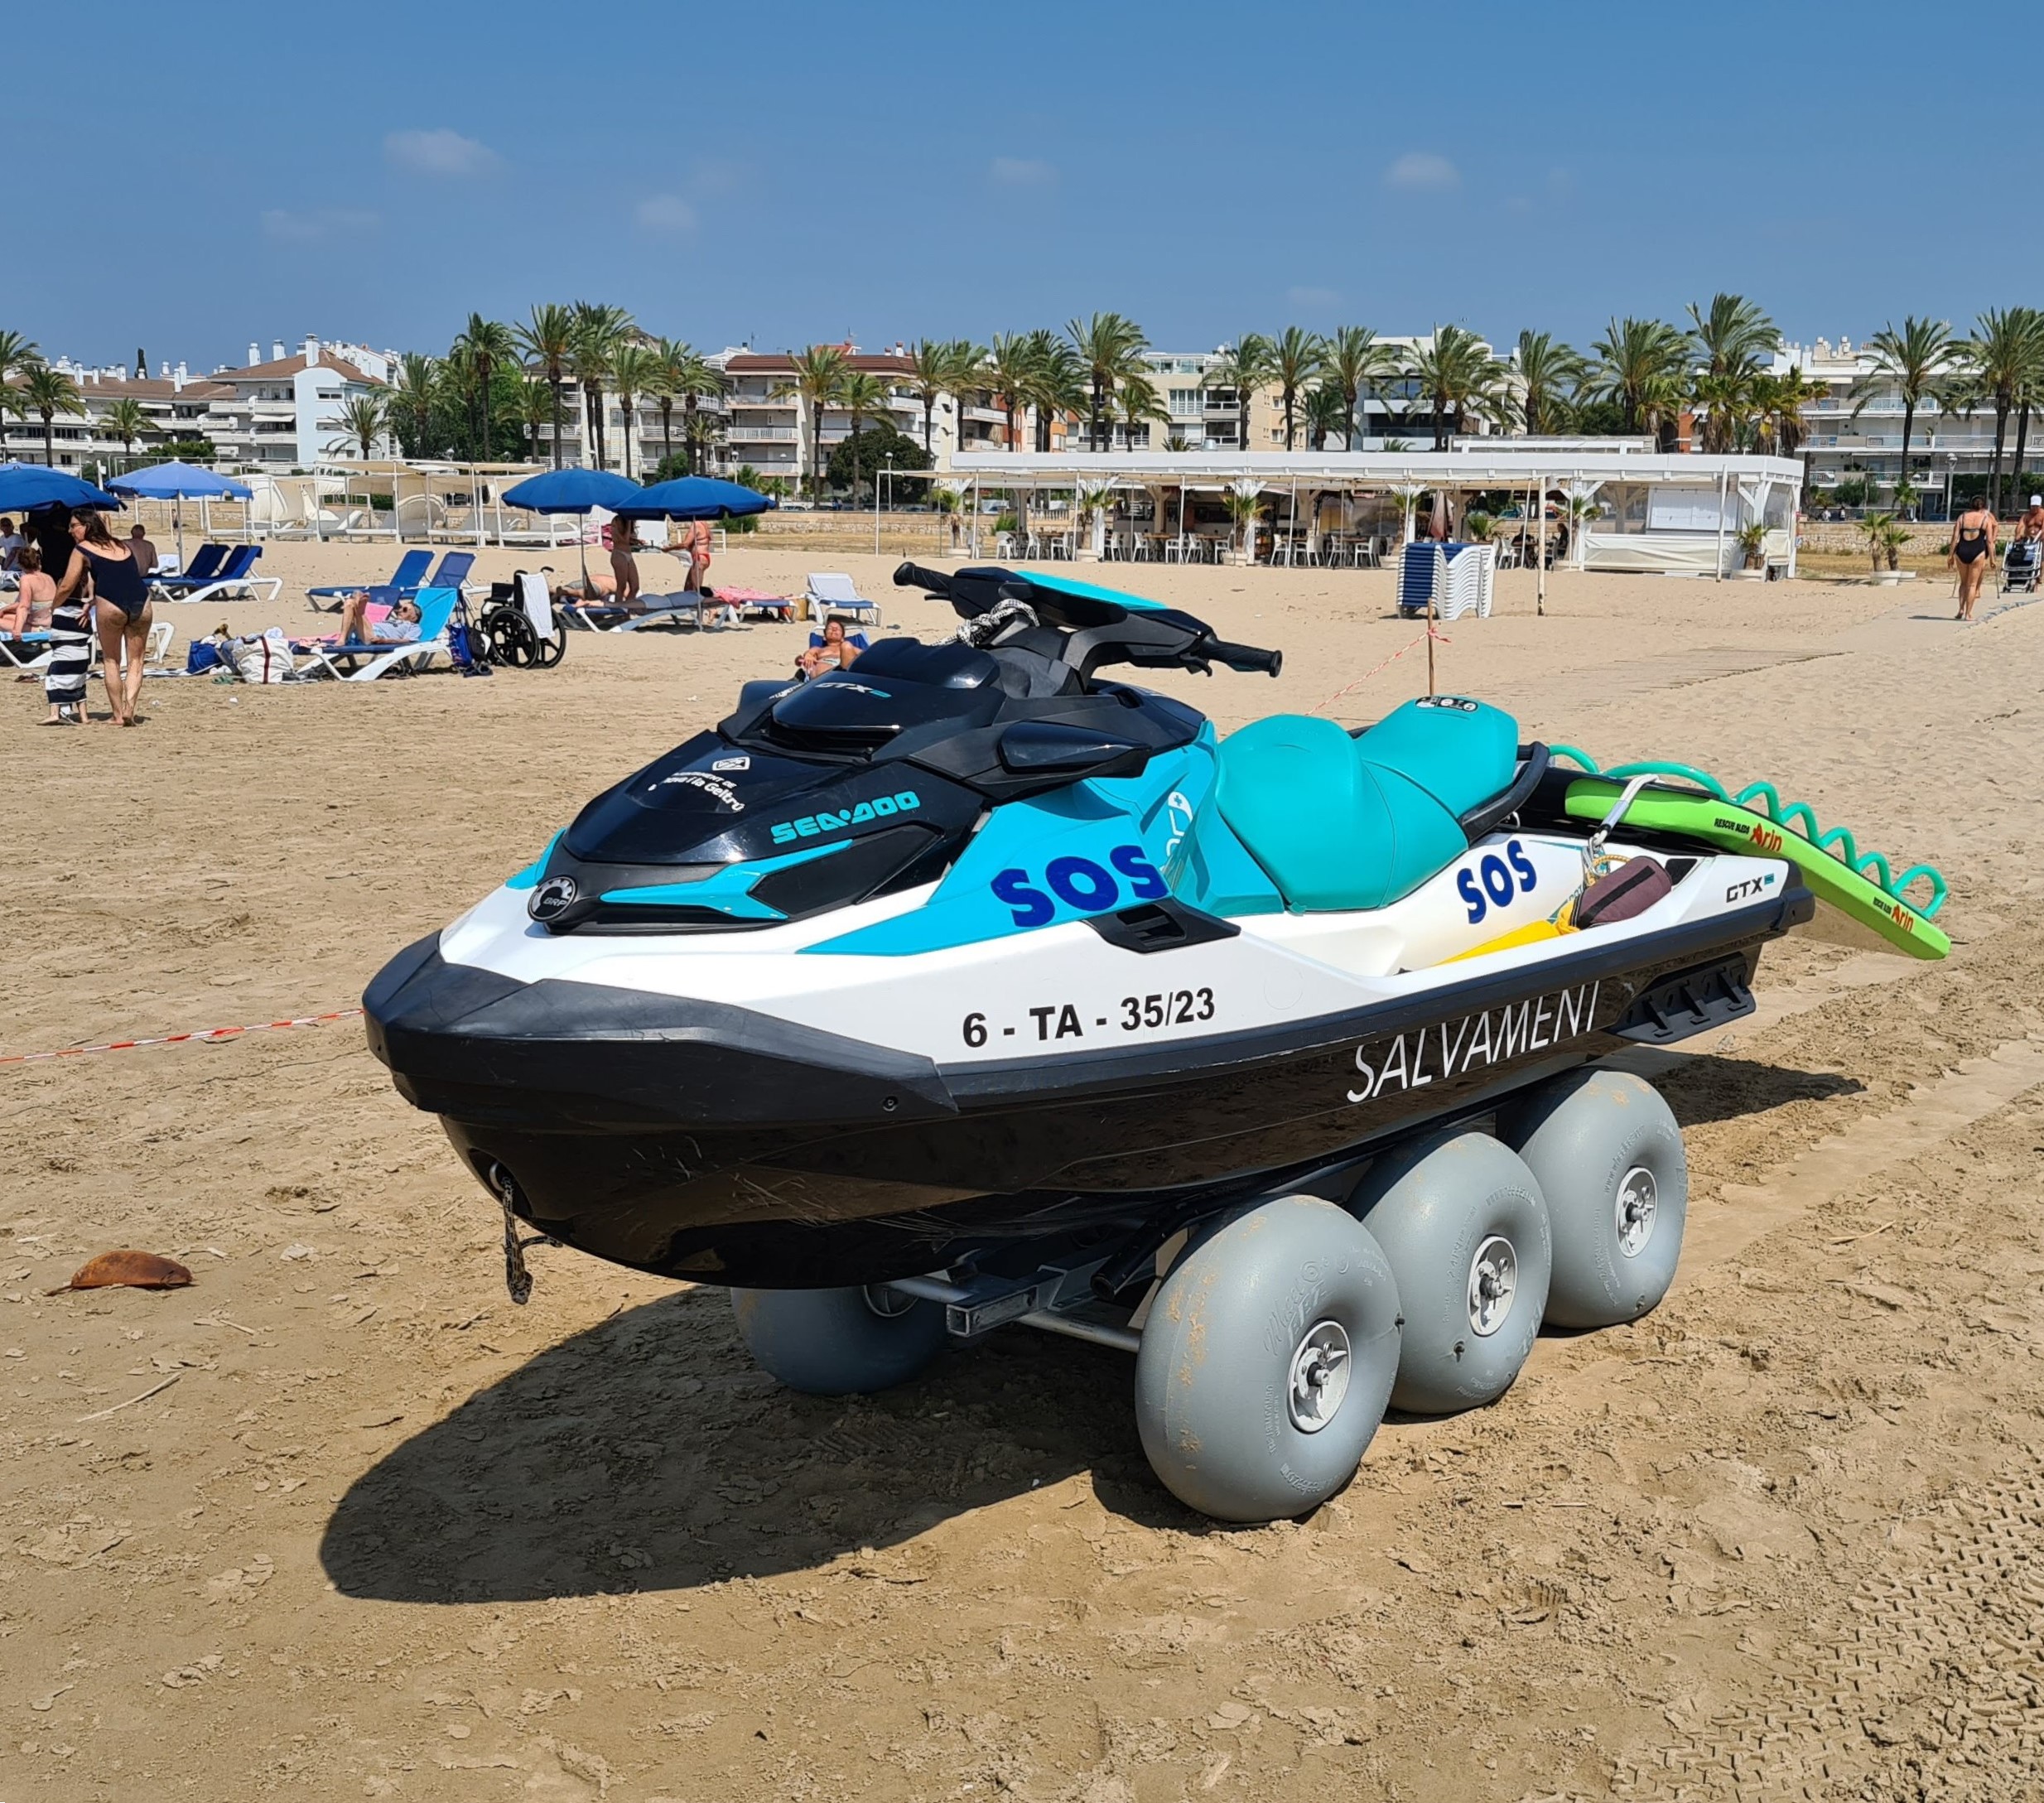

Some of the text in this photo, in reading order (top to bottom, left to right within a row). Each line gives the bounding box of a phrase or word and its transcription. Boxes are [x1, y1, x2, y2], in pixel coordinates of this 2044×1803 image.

[543, 897, 568, 907] BRP
[991, 845, 1171, 928] SOS
[1457, 840, 1537, 924] SOS
[1726, 876, 1763, 904] GTX
[962, 987, 1216, 1049] 6 - TA - 35/23
